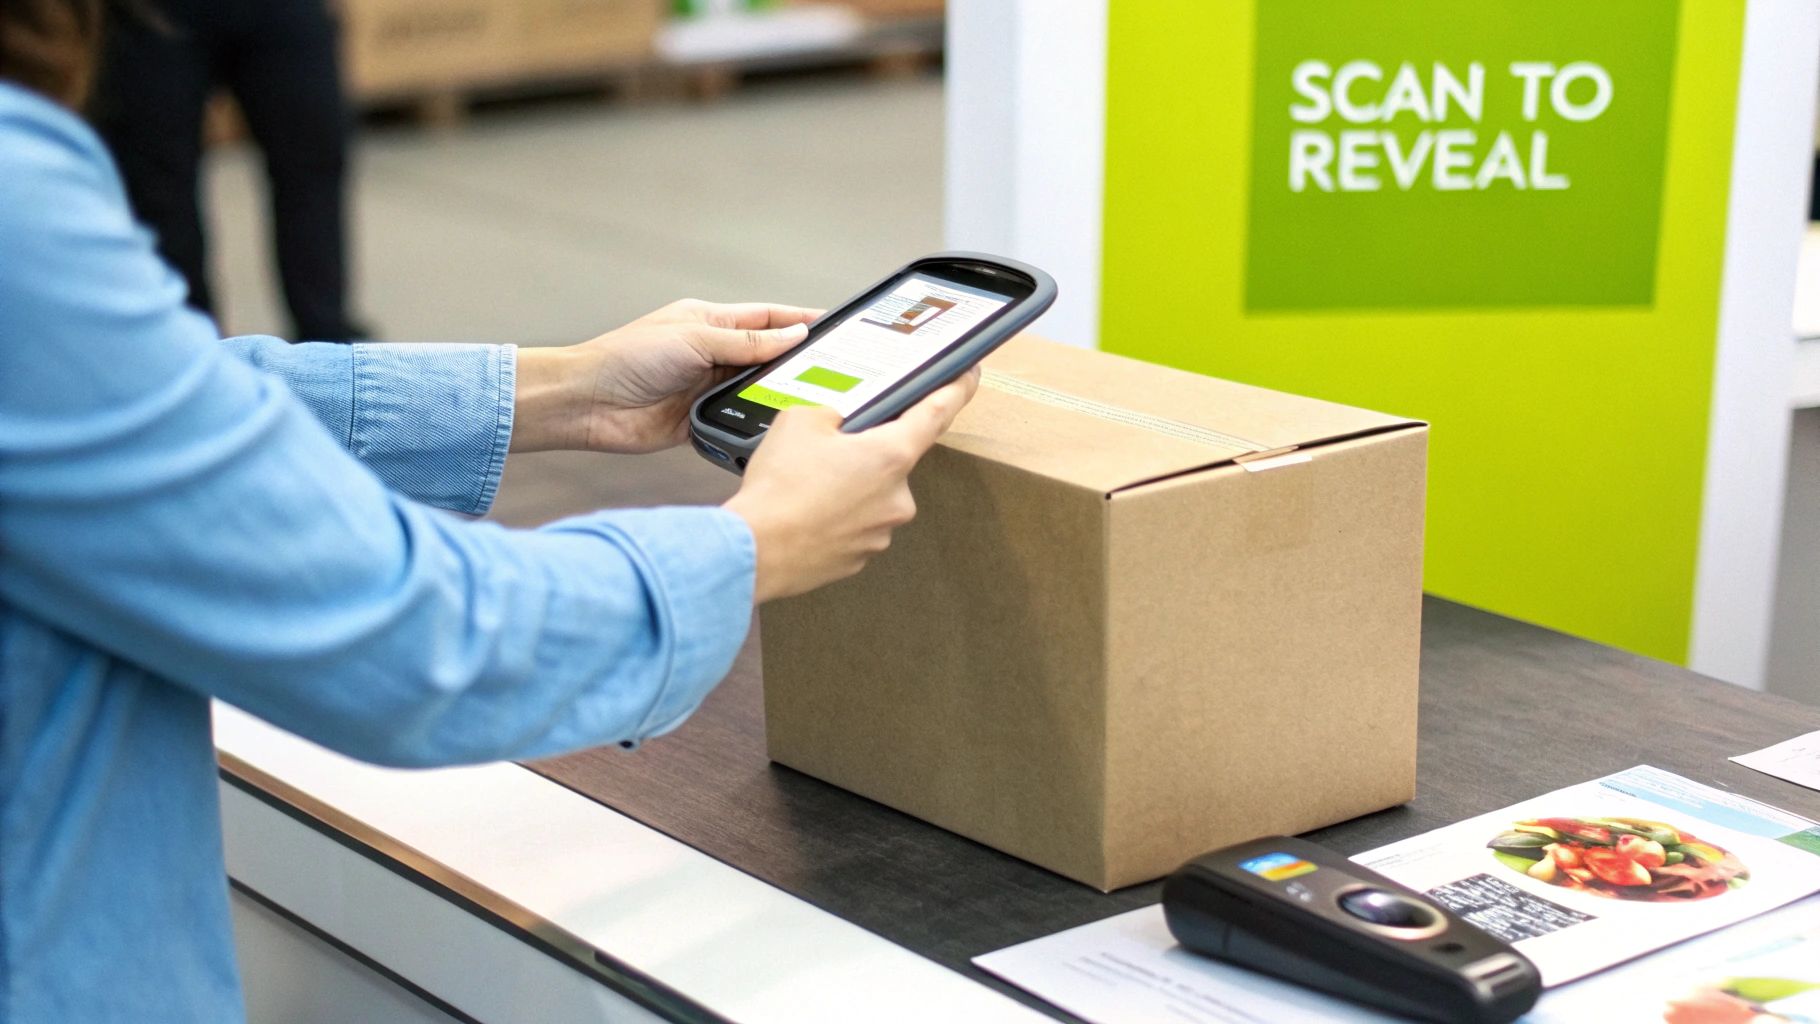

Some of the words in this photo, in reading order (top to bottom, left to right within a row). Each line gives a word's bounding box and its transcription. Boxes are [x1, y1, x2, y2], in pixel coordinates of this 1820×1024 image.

[1289, 60, 1485, 123] SCAN
[1509, 62, 1613, 121] TO
[1289, 130, 1570, 192] REVEAL
